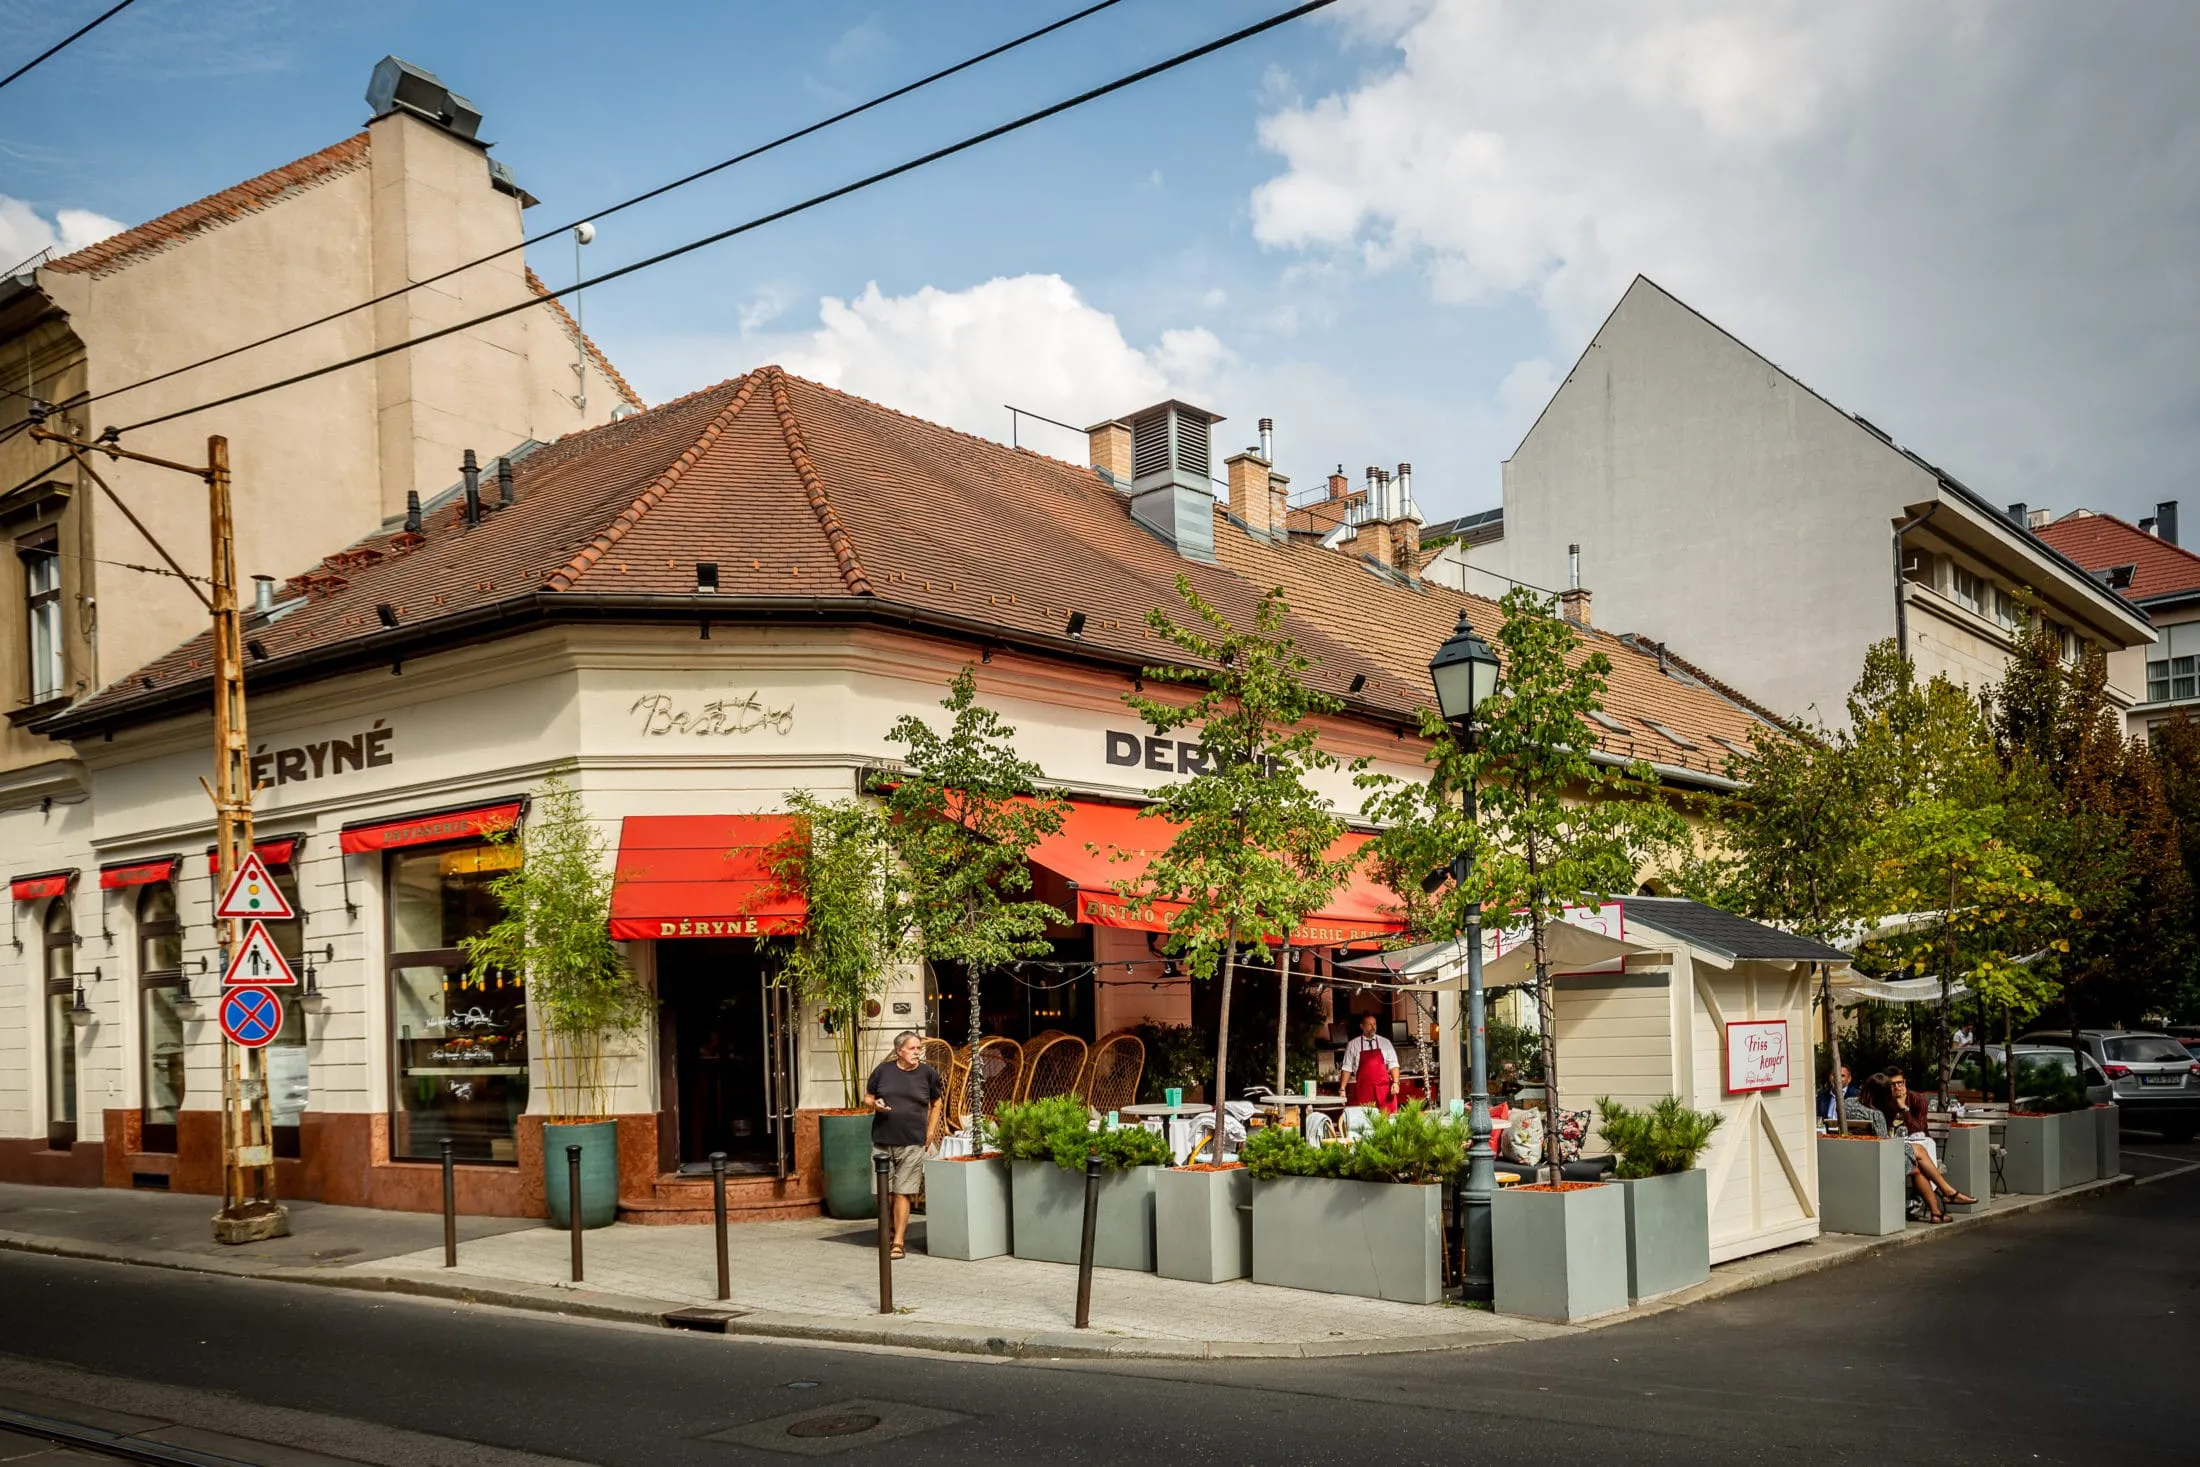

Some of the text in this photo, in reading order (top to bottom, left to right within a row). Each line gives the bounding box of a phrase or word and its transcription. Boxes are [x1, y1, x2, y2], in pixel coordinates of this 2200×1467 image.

[231, 718, 393, 797] ÉRYNÉ
[1085, 901, 1155, 923] BISTRO
[660, 917, 758, 936] DÉRYNÉ
[1289, 926, 1343, 941] SSERIE
[1744, 1034, 1768, 1052] Friss
